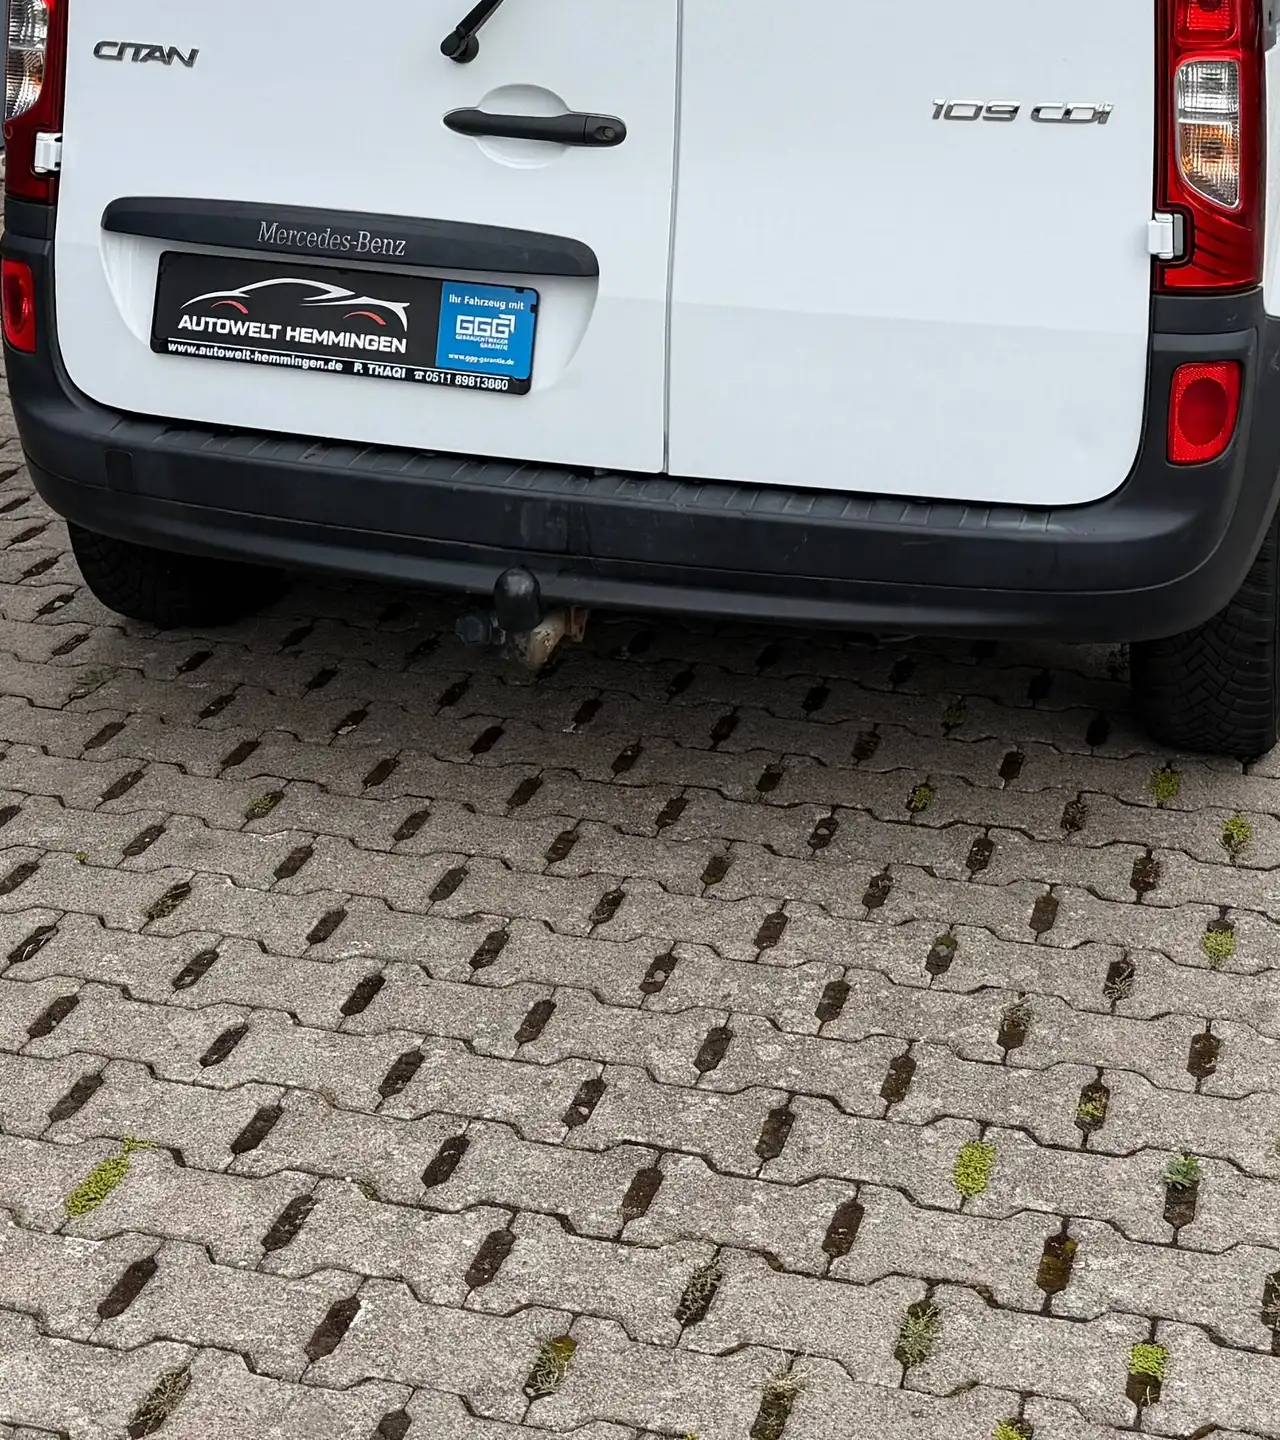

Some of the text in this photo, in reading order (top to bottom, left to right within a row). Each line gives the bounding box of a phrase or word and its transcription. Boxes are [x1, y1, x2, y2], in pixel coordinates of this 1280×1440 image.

[93, 40, 200, 68] CITAN
[932, 98, 1021, 122] 109
[257, 221, 407, 257] Mercedes-Benz
[448, 293, 524, 310] Ihr Fahrzeug mit
[178, 314, 408, 354] AUTOWELT HEMMINGEN
[455, 314, 510, 339] GGG
[167, 342, 343, 372] www.autowelt-hemmingen.de
[368, 363, 407, 379] THAQI
[425, 371, 451, 384] 0511
[455, 374, 509, 391] 89813880
